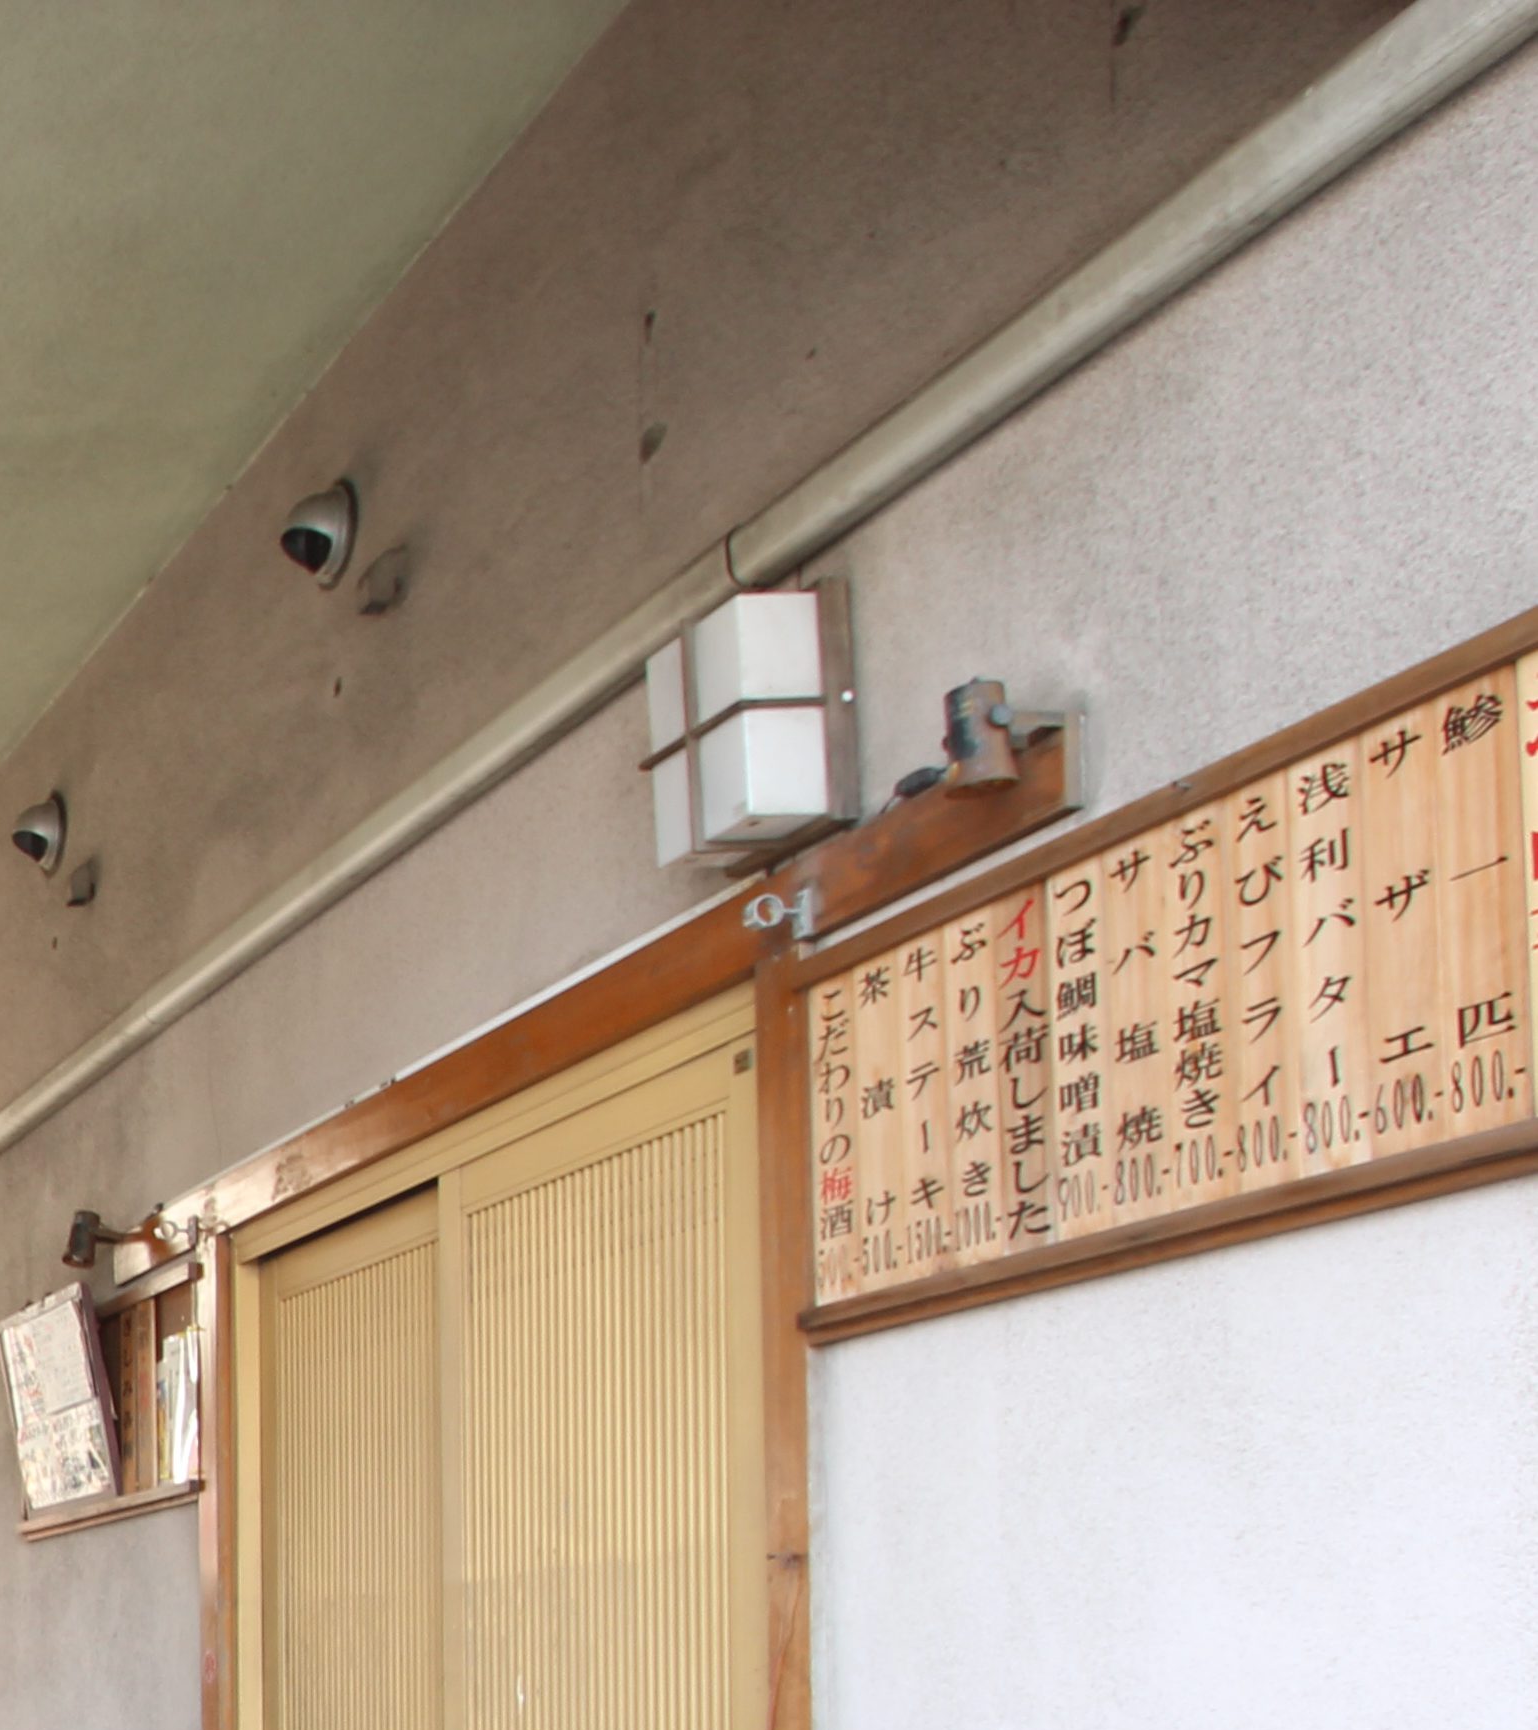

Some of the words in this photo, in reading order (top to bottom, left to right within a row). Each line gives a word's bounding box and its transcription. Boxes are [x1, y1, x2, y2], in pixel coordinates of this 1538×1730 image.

[1109, 850, 1164, 1153] サバ塩焼
[1169, 819, 1224, 1130] ぶりカマ塩焼き
[1235, 796, 1284, 1107] えびフライ
[1298, 761, 1356, 1088] 浅利バター
[1369, 729, 1435, 1064] サザエ
[817, 989, 853, 1240] こだわりの梅酒
[859, 967, 896, 1226] 茶漬け
[904, 948, 944, 1209] 牛ステーキ
[951, 923, 993, 1199] ぶり荒炊き
[997, 898, 1051, 1241] イカ入荷しました
